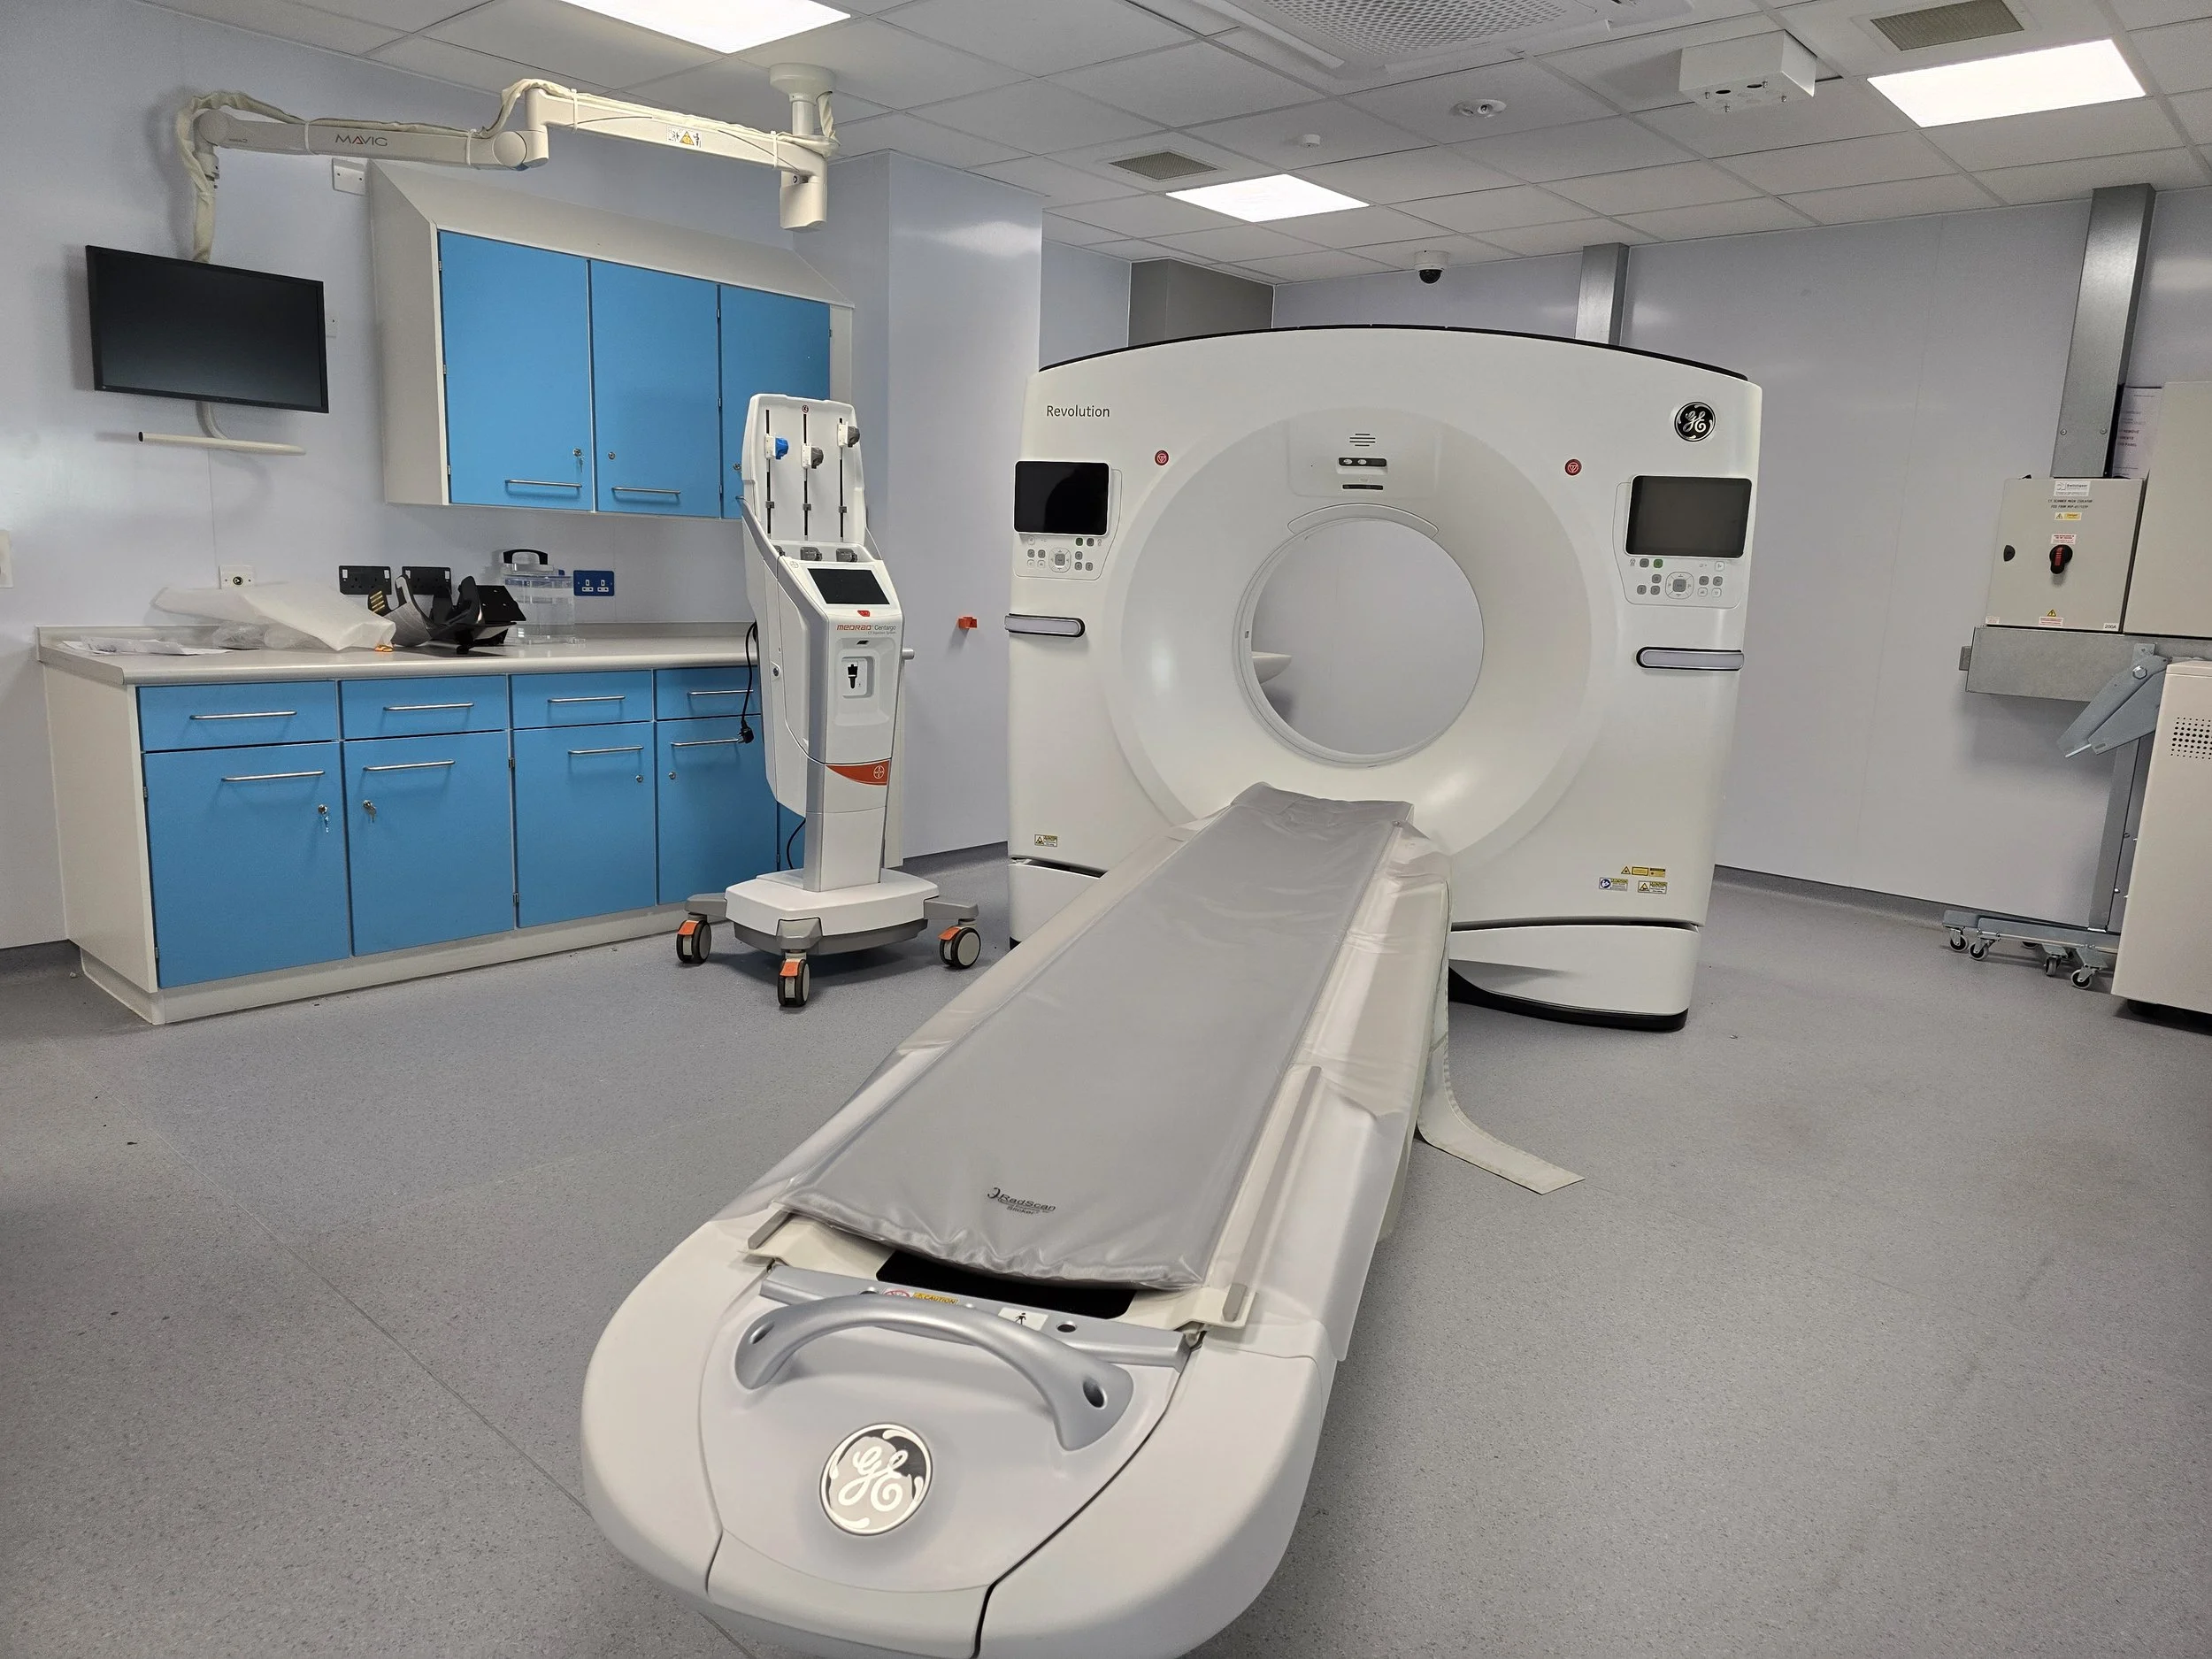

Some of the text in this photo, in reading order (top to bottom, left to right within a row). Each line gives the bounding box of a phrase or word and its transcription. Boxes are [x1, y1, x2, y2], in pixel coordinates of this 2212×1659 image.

[335, 134, 388, 147] MAVIG
[1047, 404, 1110, 418] Revolution
[998, 1194, 1056, 1211] RadScan
[924, 1295, 956, 1304] CAUTION
